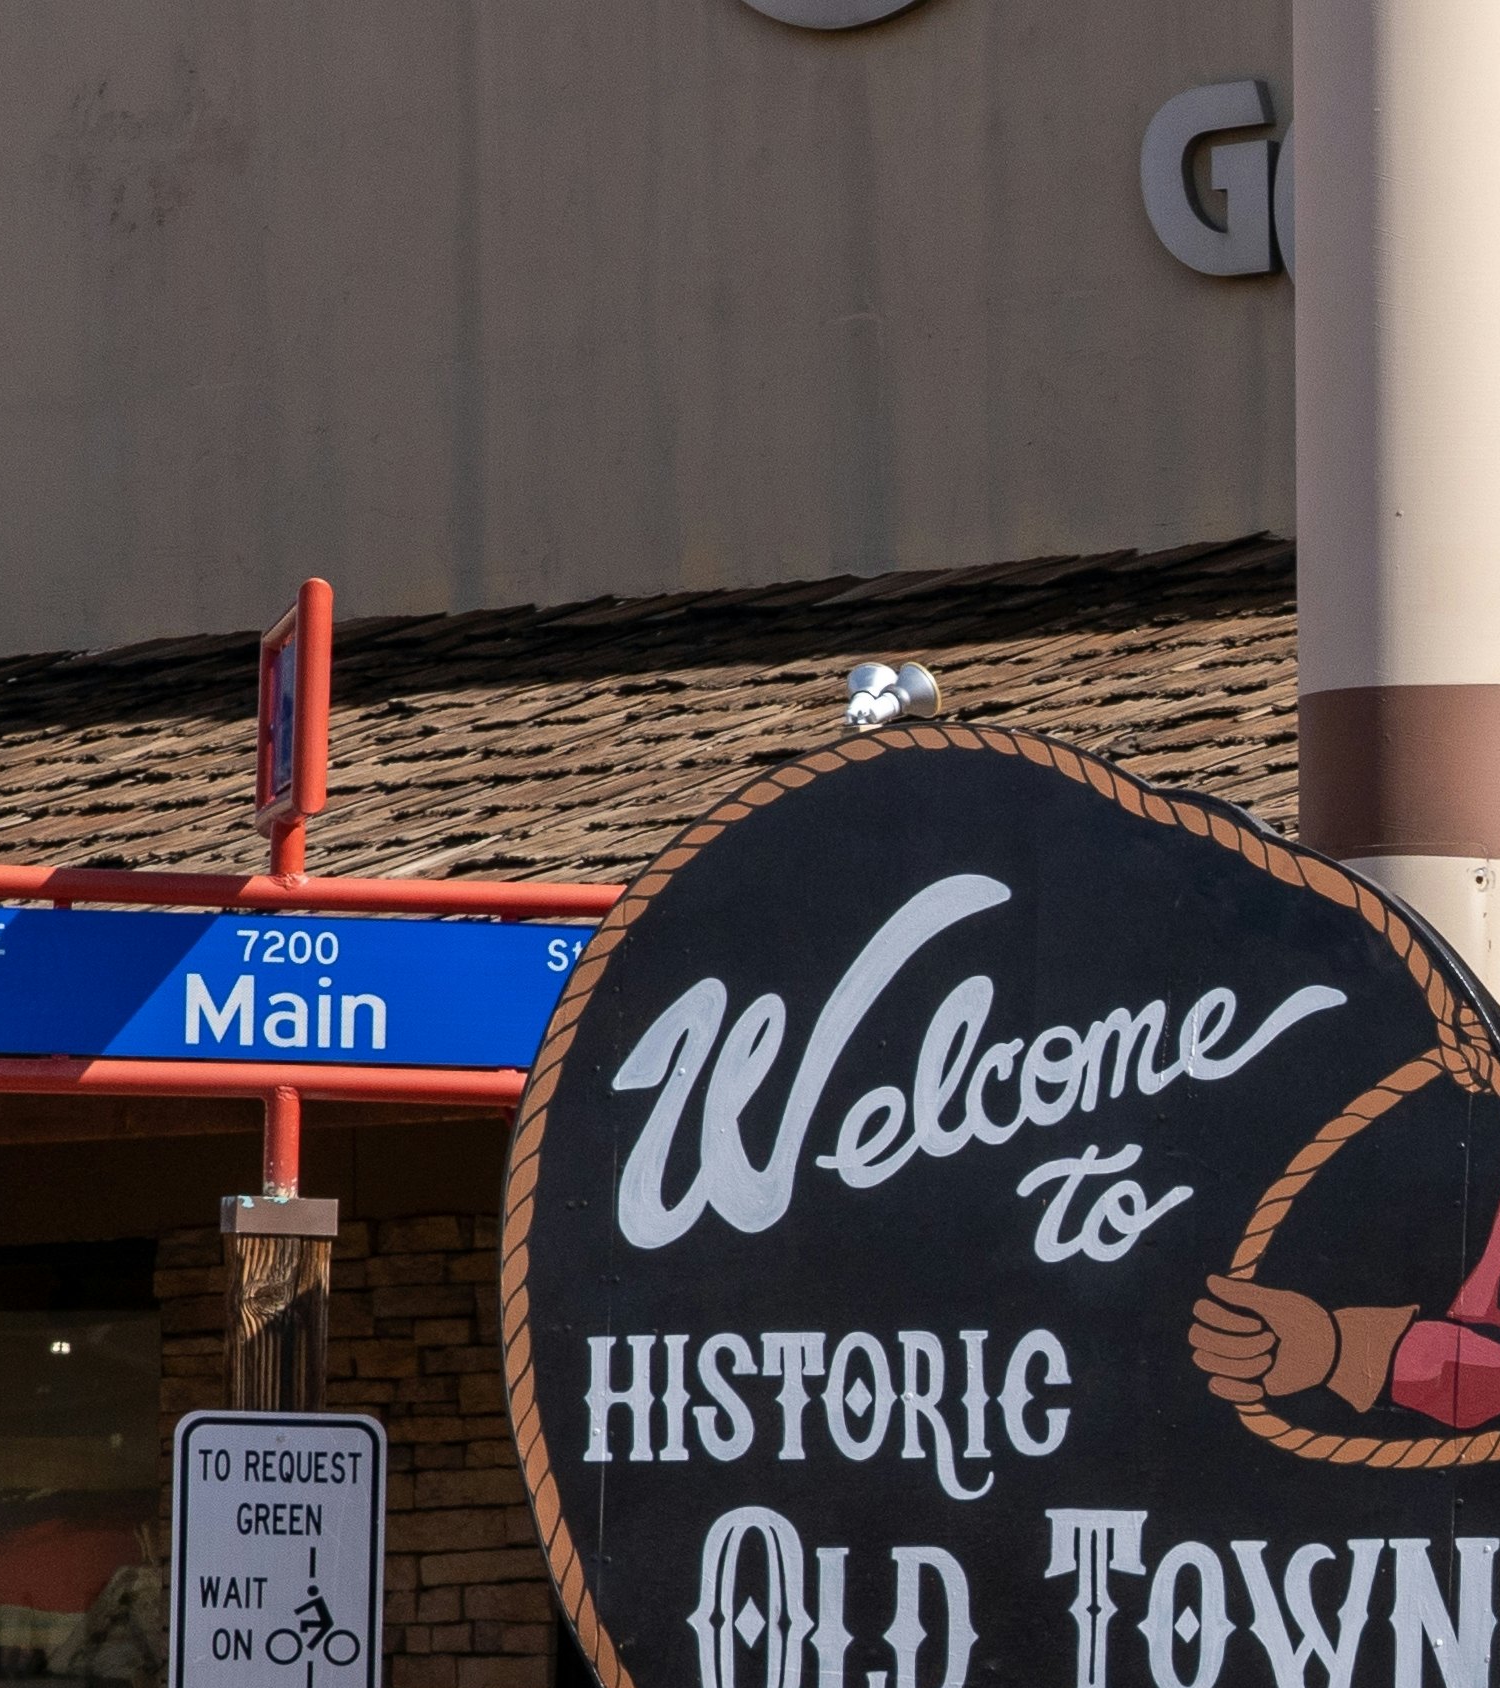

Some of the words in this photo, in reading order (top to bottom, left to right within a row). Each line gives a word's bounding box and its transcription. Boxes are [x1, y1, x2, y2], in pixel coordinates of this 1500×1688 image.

[236, 930, 341, 966] 7200
[185, 974, 388, 1051] Main
[612, 873, 1349, 1250] Welcome
[1016, 1143, 1195, 1263] to
[582, 1329, 1072, 1500] HISTORIC
[198, 1449, 233, 1483] TO
[244, 1450, 365, 1486] REQUEST
[237, 1503, 324, 1538] GREEN
[199, 1576, 269, 1611] WAIT
[212, 1628, 254, 1663] ON
